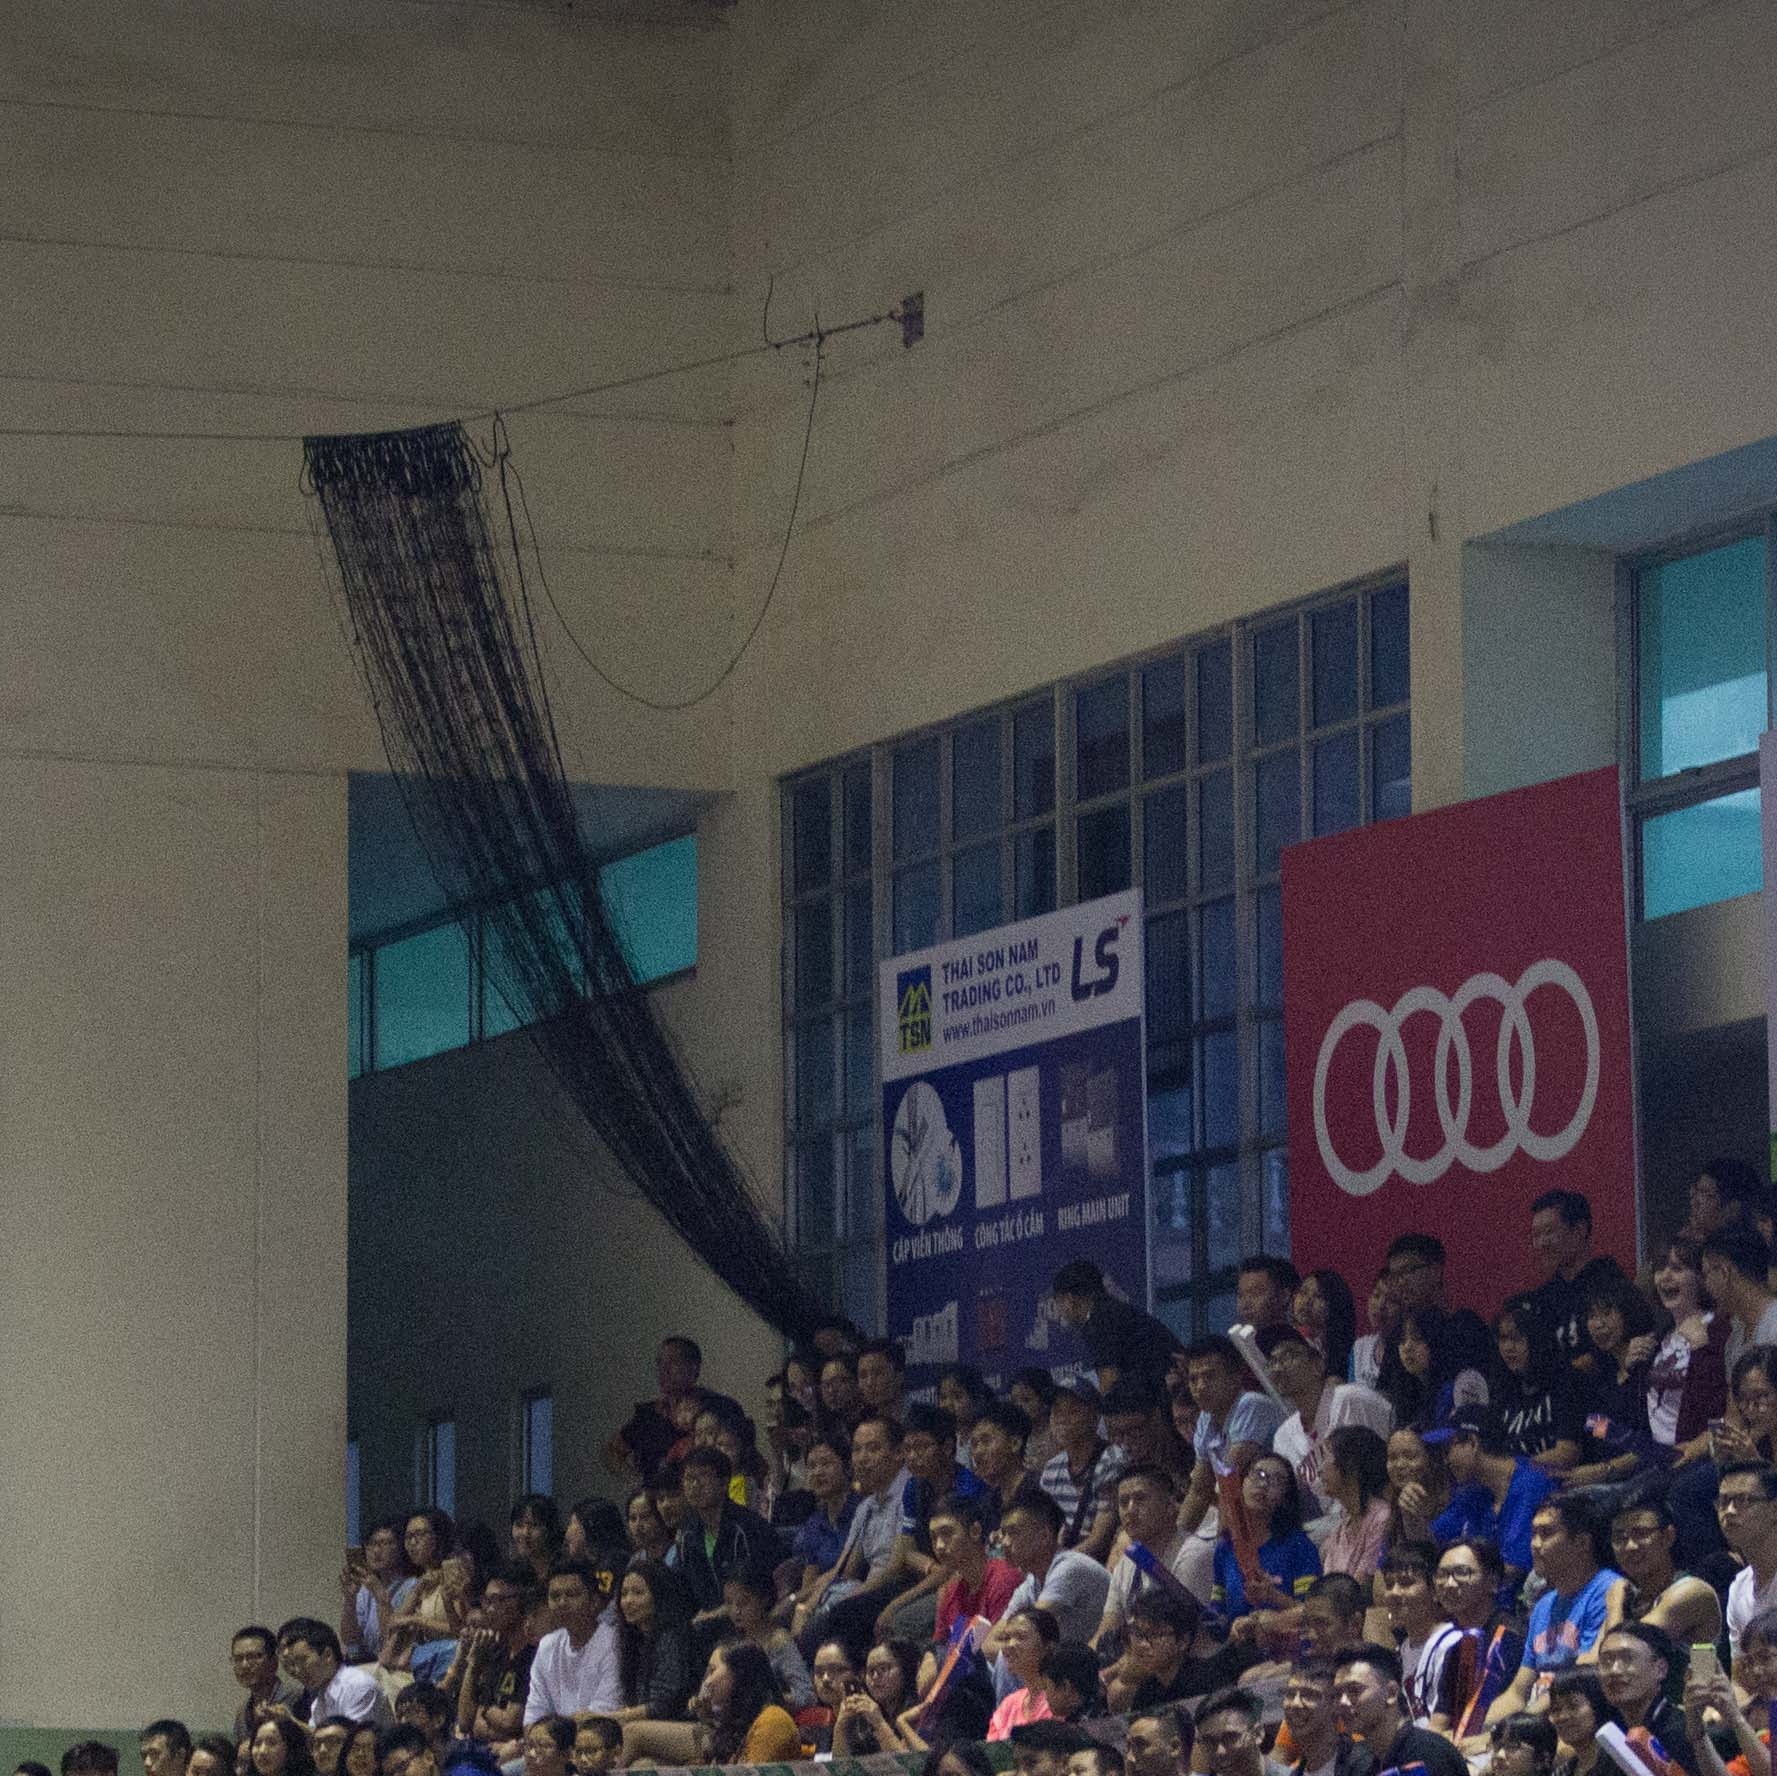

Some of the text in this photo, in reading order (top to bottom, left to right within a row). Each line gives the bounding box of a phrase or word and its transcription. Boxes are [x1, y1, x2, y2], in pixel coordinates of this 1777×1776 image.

[942, 938, 1039, 985] THAI SON NAM
[1071, 927, 1120, 1002] LS
[942, 982, 1001, 1014] TRADING
[1035, 962, 1061, 989] LTD
[899, 1017, 932, 1050] TSN
[942, 999, 1056, 1044] www.thaisonnam.vn
